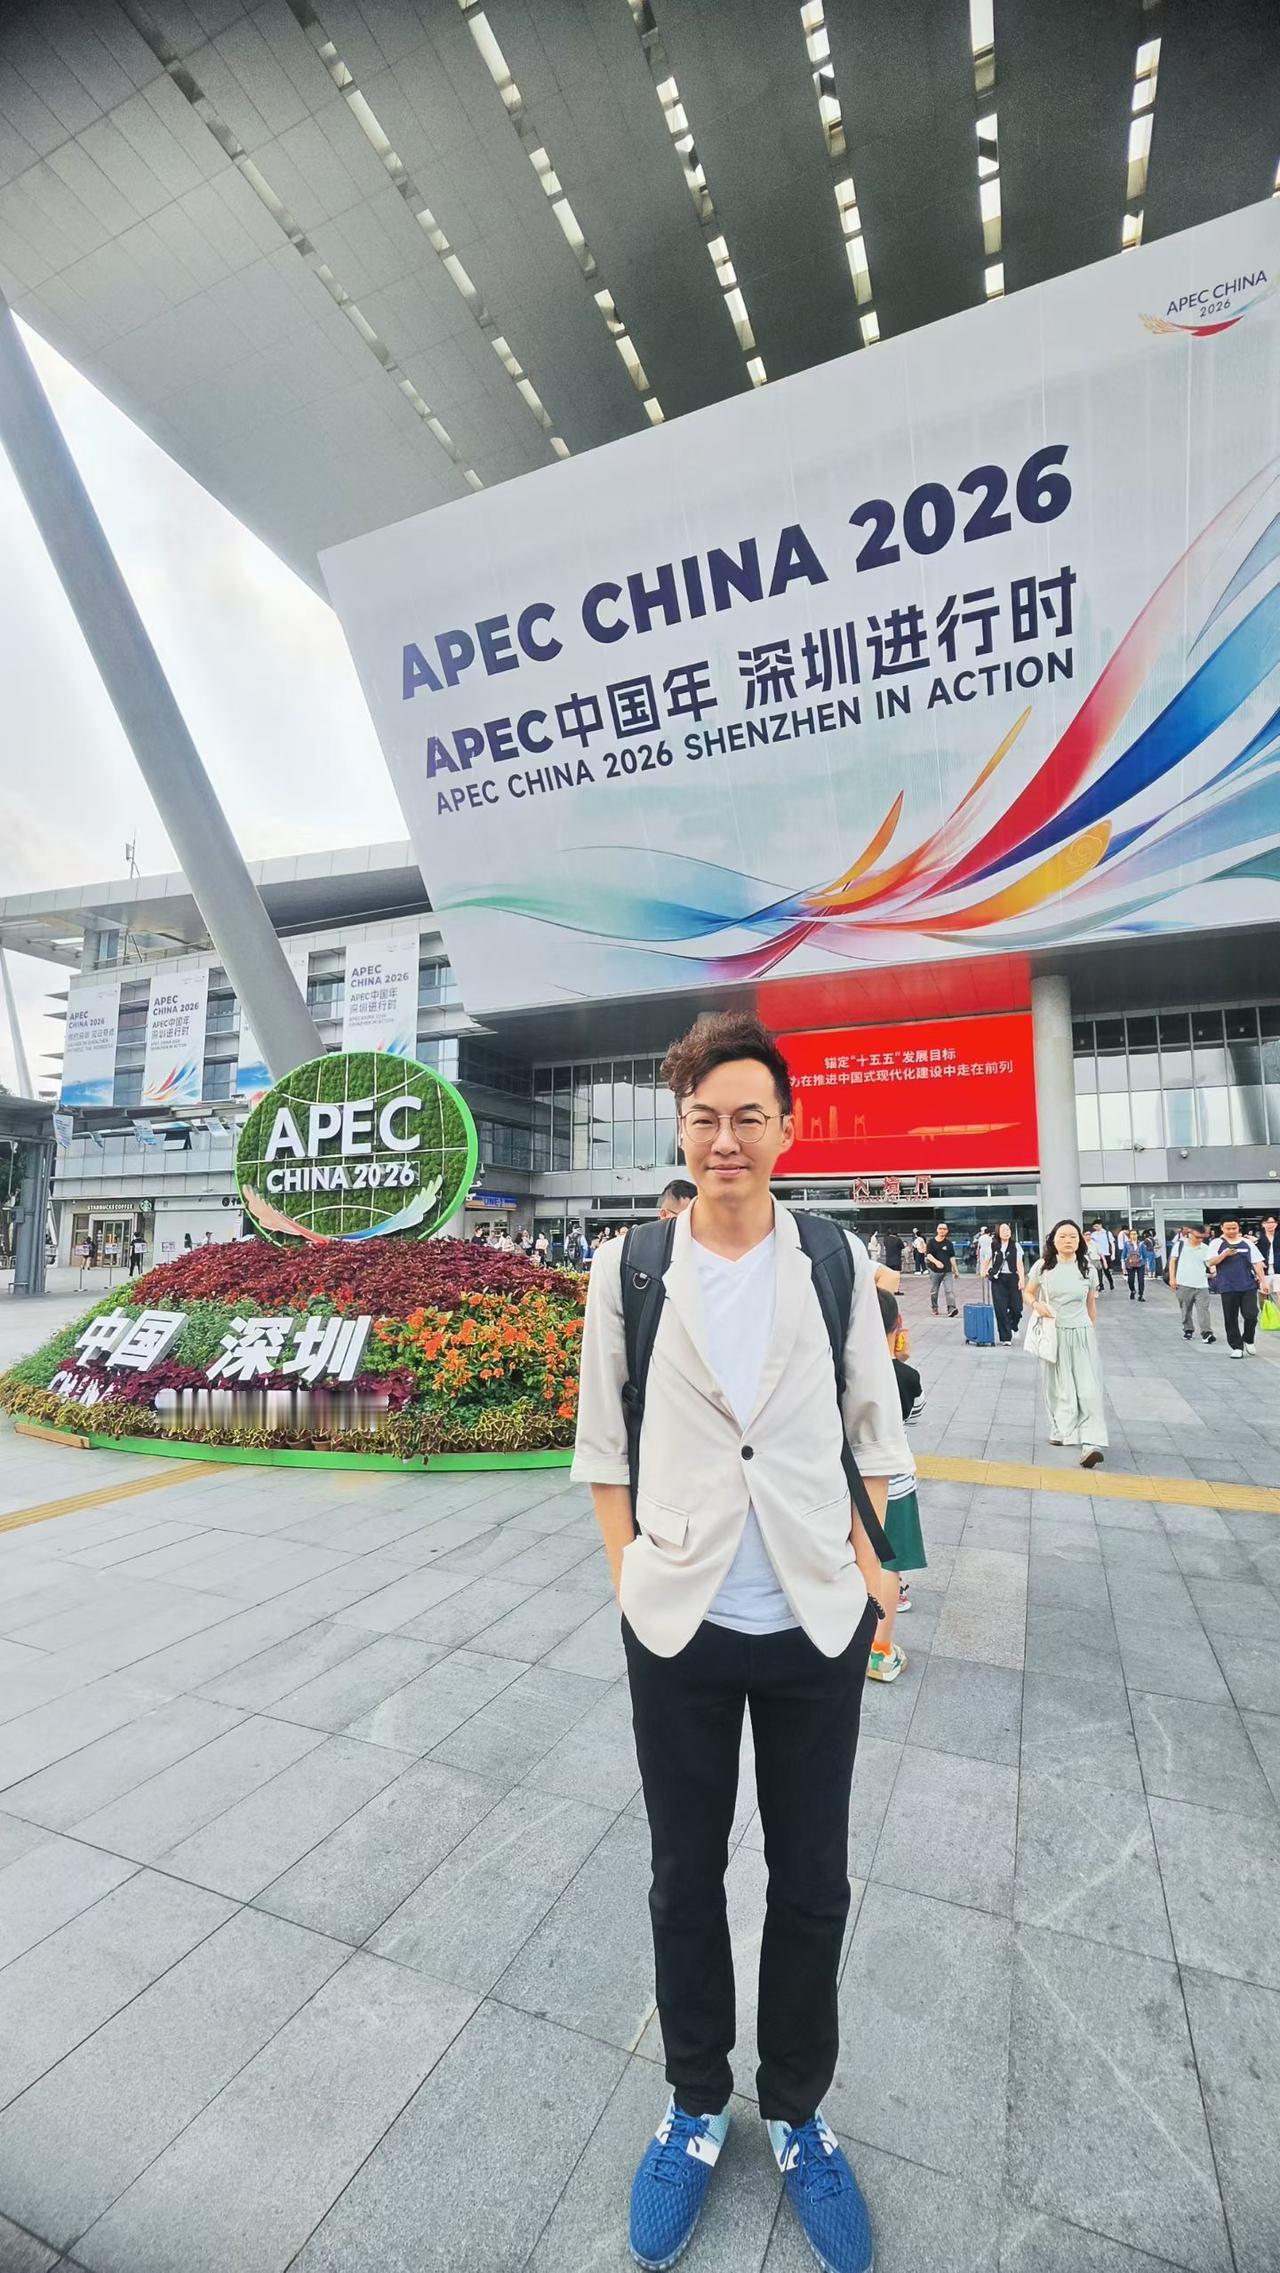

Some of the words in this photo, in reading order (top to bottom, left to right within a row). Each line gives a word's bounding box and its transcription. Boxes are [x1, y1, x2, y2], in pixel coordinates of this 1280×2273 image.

[1166, 289, 1209, 316] APEC
[1212, 269, 1268, 299] CHINA
[1200, 299, 1231, 318] 2026
[402, 602, 563, 701] APEC
[581, 523, 830, 663] CHINA
[848, 443, 1073, 574] 2026
[426, 660, 719, 780] APEC中国年
[738, 565, 1077, 711] 深圳进行时
[438, 779, 499, 815] APEC
[507, 758, 595, 799] CHINA
[603, 739, 673, 780] 2026
[684, 696, 862, 761] SHENZHEN
[876, 684, 912, 720] IN
[927, 647, 1075, 709] ACTION
[351, 977, 382, 988] CHINA
[385, 973, 409, 984] 2026
[352, 965, 382, 977] APEC
[70, 1011, 88, 1020] APEC
[153, 1006, 178, 1016] CHINA
[181, 1002, 199, 1012] 2026
[154, 995, 178, 1006] APEC
[265, 1095, 422, 1162] APEC
[266, 1165, 348, 1193] CHINA
[353, 1162, 415, 1189] 2026
[74, 1307, 190, 1372] 中国
[206, 1315, 372, 1385] 深圳
